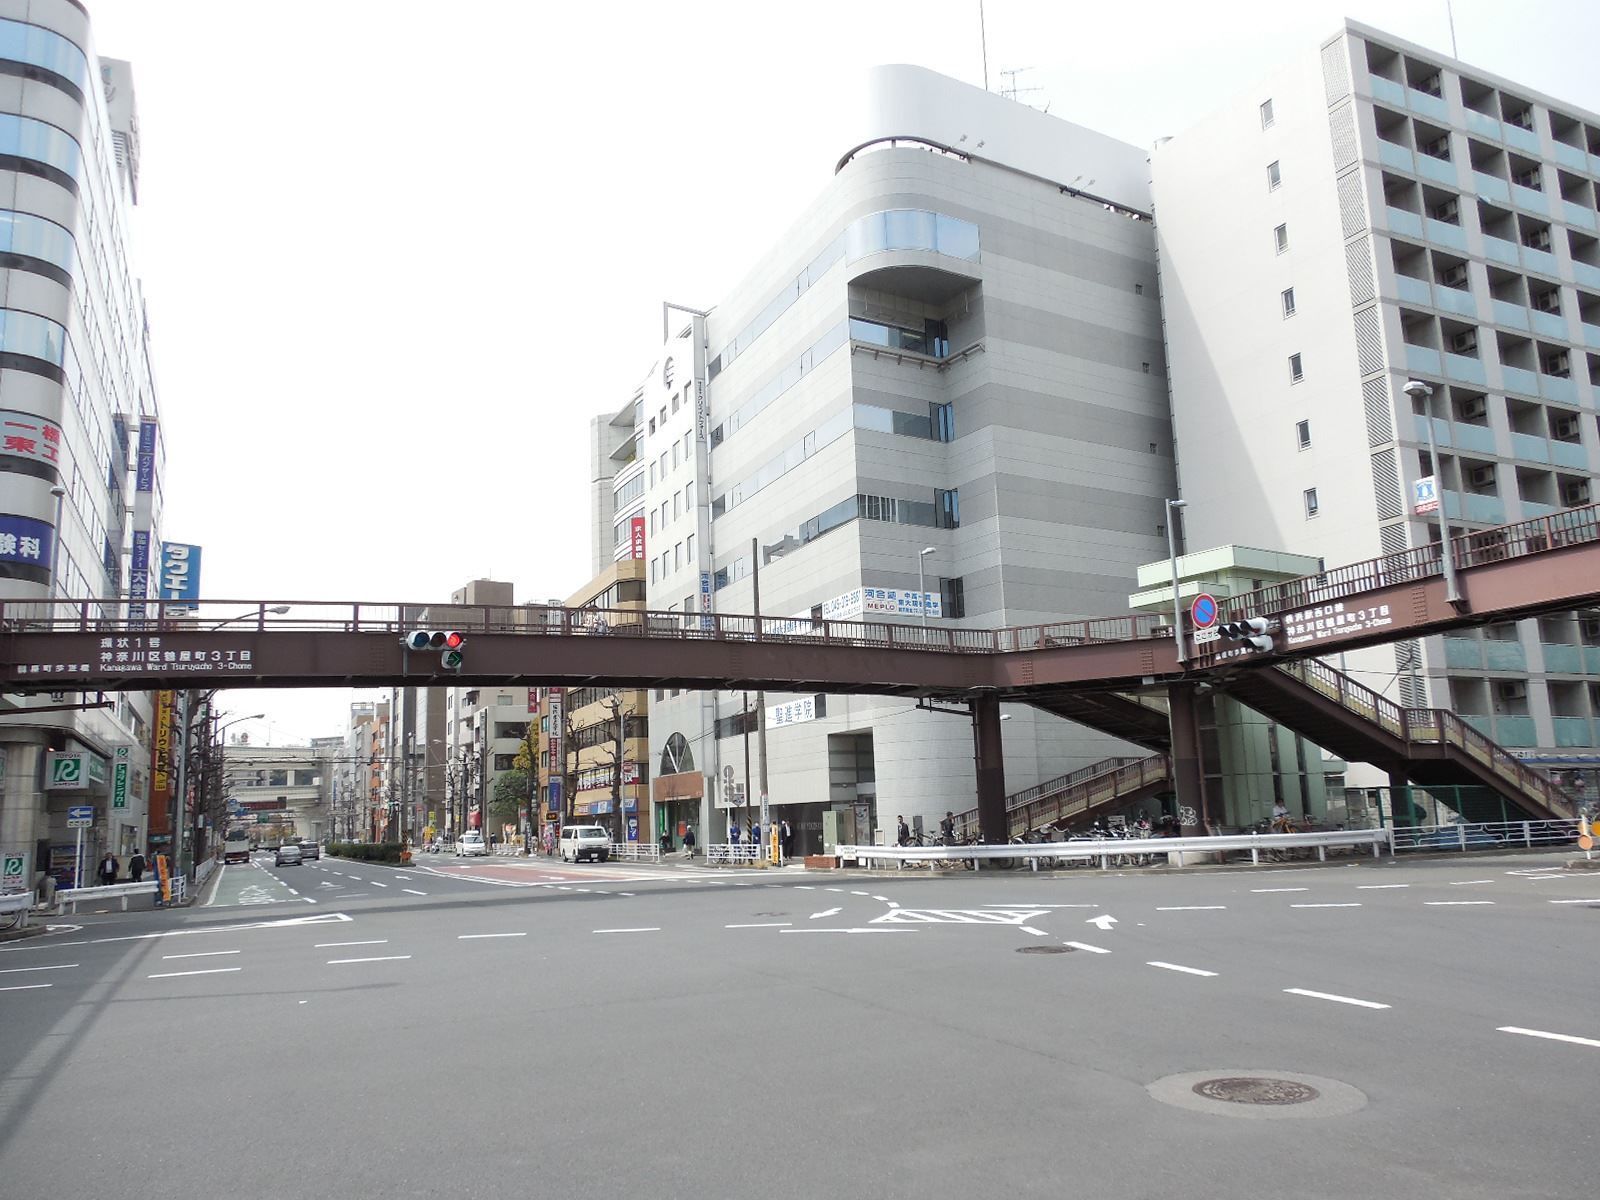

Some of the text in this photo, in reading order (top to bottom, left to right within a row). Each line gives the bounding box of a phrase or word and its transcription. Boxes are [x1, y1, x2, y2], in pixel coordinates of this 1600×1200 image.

[864, 588, 897, 601] 河合塾
[867, 602, 896, 611] MEPLO
[100, 638, 160, 649] 環状1号
[100, 651, 251, 662] 神奈川区鶴屋町3丁目
[100, 662, 252, 673] Kanagawa Ward Tsuruyacho 3-Chome
